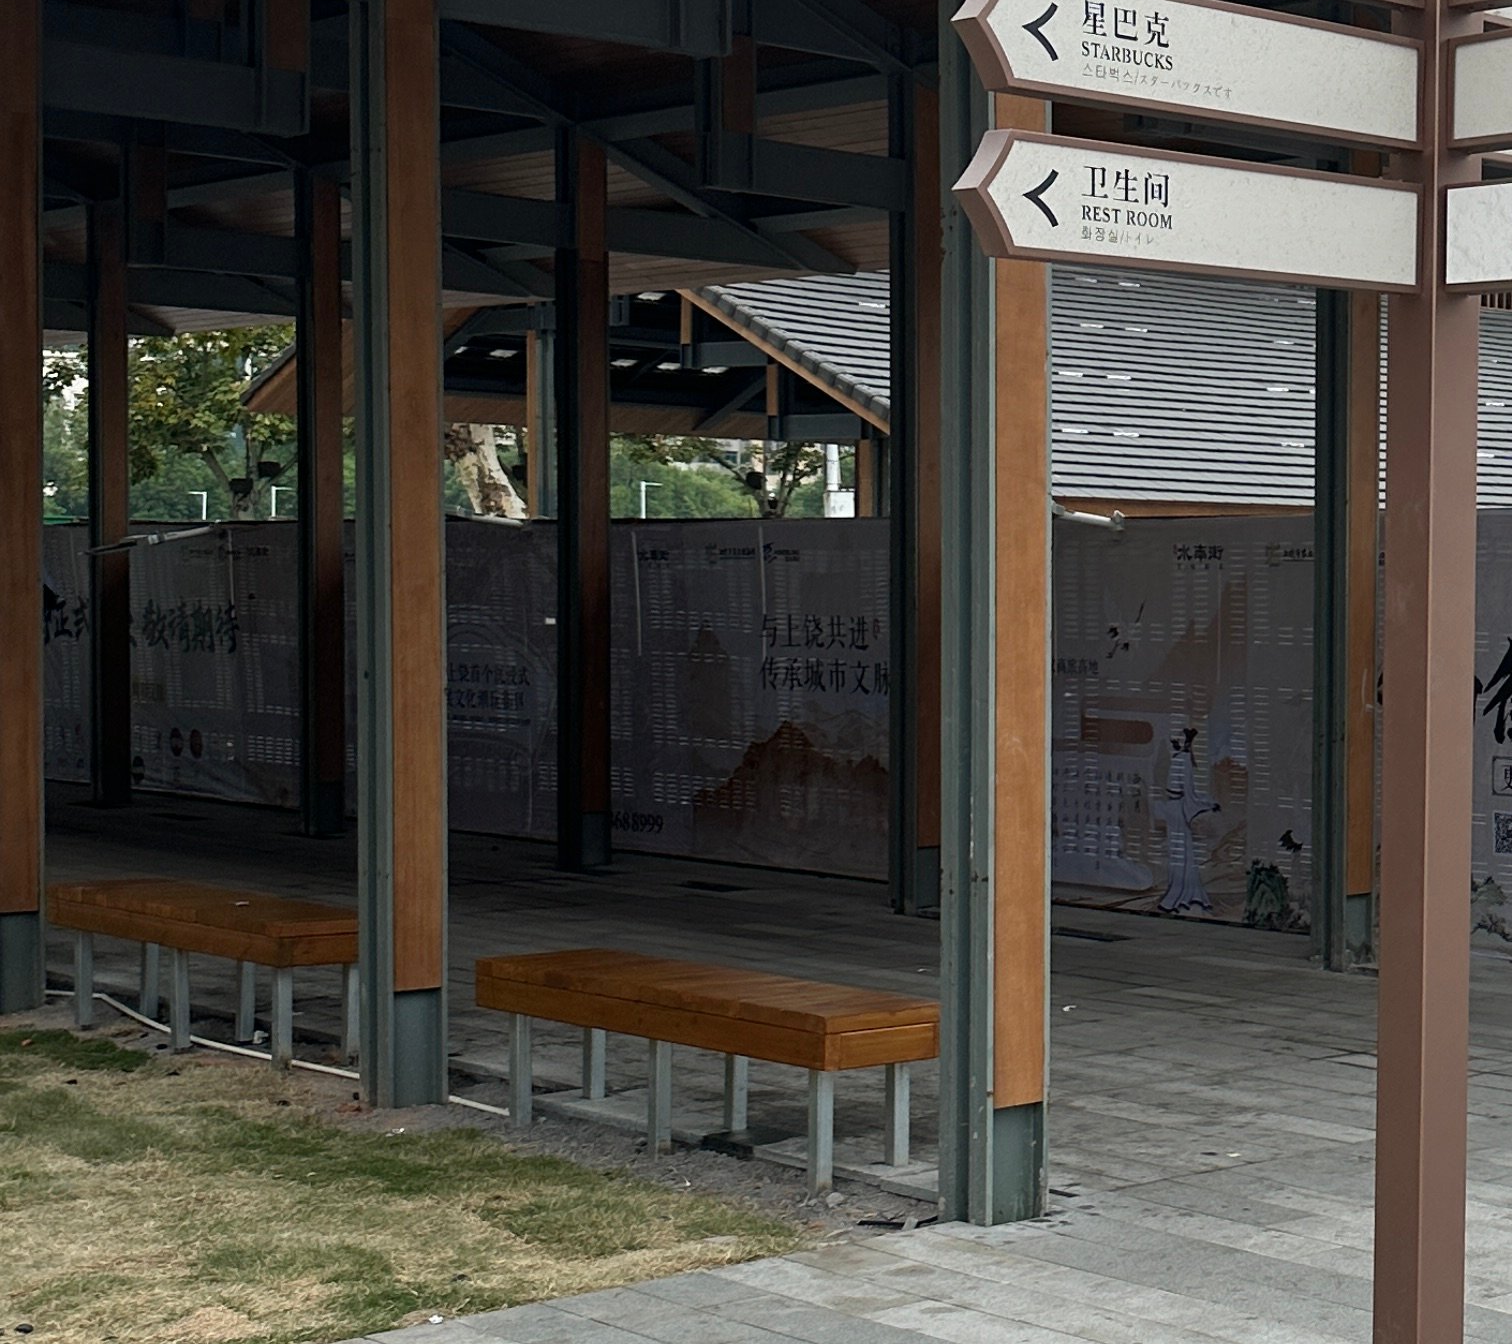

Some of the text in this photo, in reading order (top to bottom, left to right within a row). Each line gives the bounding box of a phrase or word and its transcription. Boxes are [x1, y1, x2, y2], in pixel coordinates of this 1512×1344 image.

[1082, 0, 1170, 49] 星巴克
[1081, 40, 1173, 71] STARBUCKS
[1082, 165, 1170, 208] 卫生间
[1081, 204, 1173, 230] REST ROOM
[760, 613, 870, 650] 与上饶共进
